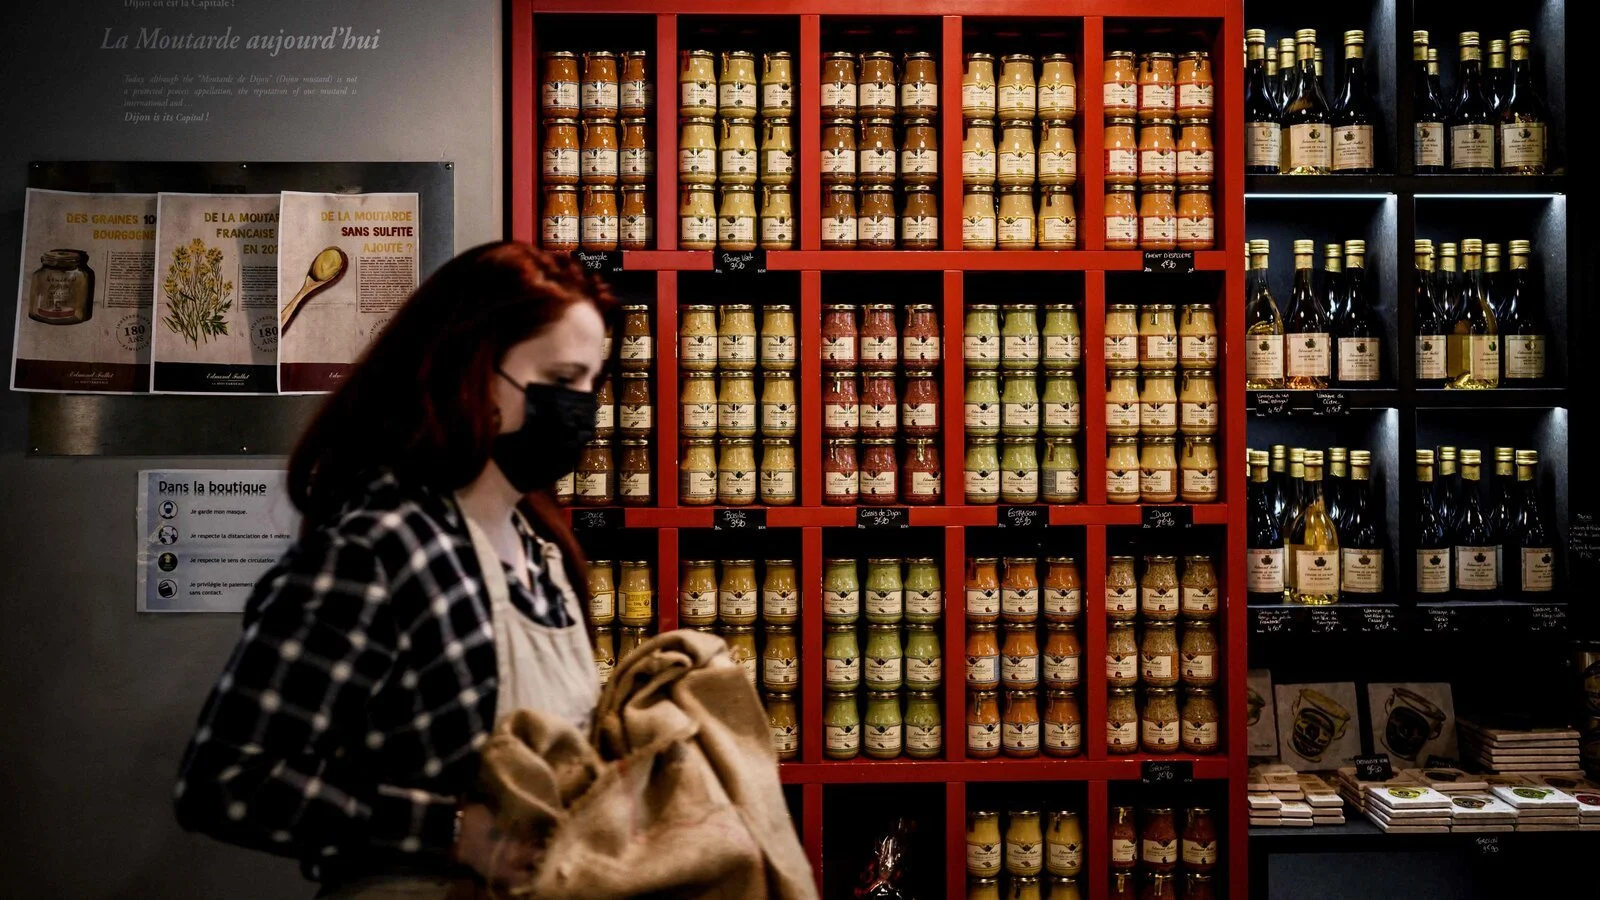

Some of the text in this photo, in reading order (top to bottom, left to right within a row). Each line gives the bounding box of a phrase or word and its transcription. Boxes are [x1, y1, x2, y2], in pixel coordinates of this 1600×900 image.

[100, 26, 382, 57] La Moutarde aujourd'hui
[124, 111, 152, 125] Dijon
[152, 112, 161, 122] is
[163, 112, 175, 122] its
[175, 112, 205, 124] Capital
[66, 213, 88, 225] DES
[92, 214, 139, 225] GRAINES
[204, 212, 219, 223] DE
[221, 212, 236, 223] LA
[321, 210, 413, 222] DE LA MOUTARDE
[93, 230, 157, 241] BOURGOGNE
[341, 226, 414, 237] SANS SULFITE
[243, 244, 259, 254] EN
[405, 242, 414, 253] ?
[123, 324, 146, 338] 180
[259, 326, 279, 338] 180
[127, 334, 145, 345] ANS
[158, 480, 268, 495] Dans la boutique
